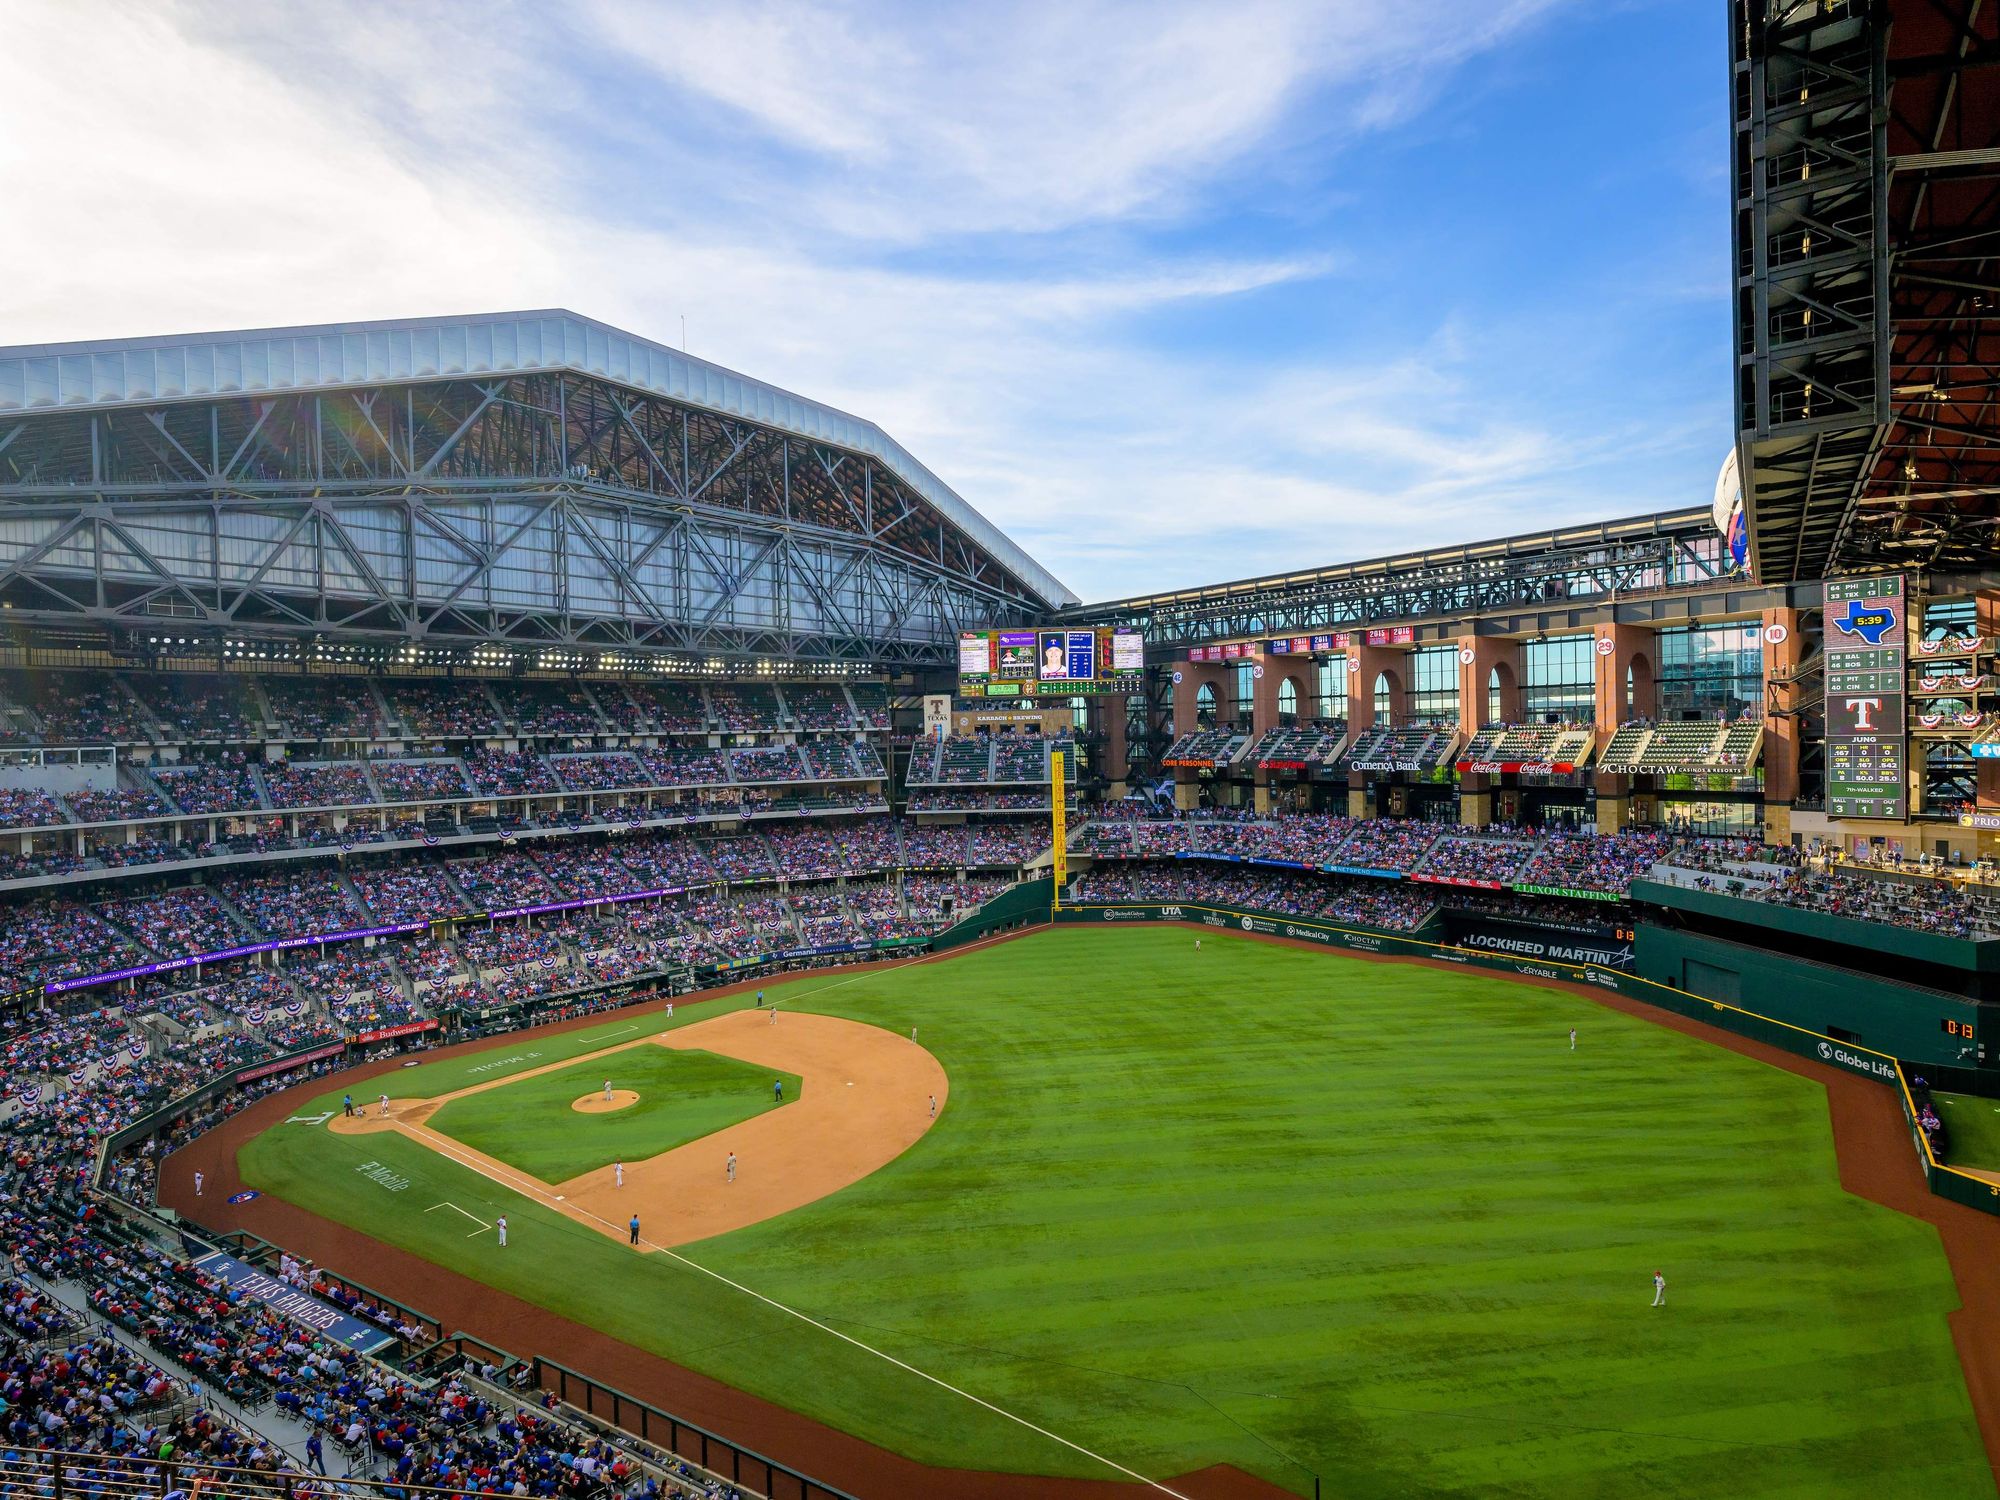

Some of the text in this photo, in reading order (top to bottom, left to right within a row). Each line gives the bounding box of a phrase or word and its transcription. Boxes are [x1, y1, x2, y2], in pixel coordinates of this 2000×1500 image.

[1857, 616, 1882, 625] 5:39
[1369, 629, 1385, 638] 2015
[1394, 627, 1409, 636] 2016
[1769, 629, 1782, 639] 10
[1599, 641, 1612, 651] 29
[1464, 652, 1470, 661] 7
[1349, 661, 1358, 669] 26
[1846, 699, 1882, 731] T
[1396, 761, 1421, 770] Bank
[1608, 764, 1678, 774] CHOCTAW
[1974, 817, 1999, 826] PRIO
[1187, 852, 1230, 860] SHERWIN-WILLIAMS
[1523, 885, 1617, 901] LUXOR STAFFING
[1162, 907, 1182, 915] UTA
[397, 922, 424, 931] ACU.EDU
[1540, 922, 1598, 934] AHEAD-READY
[1296, 928, 1329, 941] Medical City
[1348, 934, 1381, 945] CHOCTAW
[222, 948, 246, 956] CHRISTIAN
[278, 939, 308, 947] ACU.EDU
[1469, 934, 1611, 965] LOCKHEED MARTIN
[783, 948, 817, 958] Germania
[67, 959, 187, 988] ABILENE CHRISTIAN UNIVERSITY ACU.EDU
[1516, 965, 1557, 979] VERYABLE
[1599, 973, 1614, 981] ENERGY
[1599, 978, 1618, 988] TRANSFER
[555, 998, 573, 1006] Kroger
[379, 1024, 421, 1039] Budweiser
[1949, 1020, 1972, 1039] 0:13
[307, 1052, 324, 1060] boost
[467, 1056, 524, 1073] Mobile
[1834, 1050, 1895, 1079] Globe Life
[236, 1273, 344, 1329] TEXAS RANGERS
